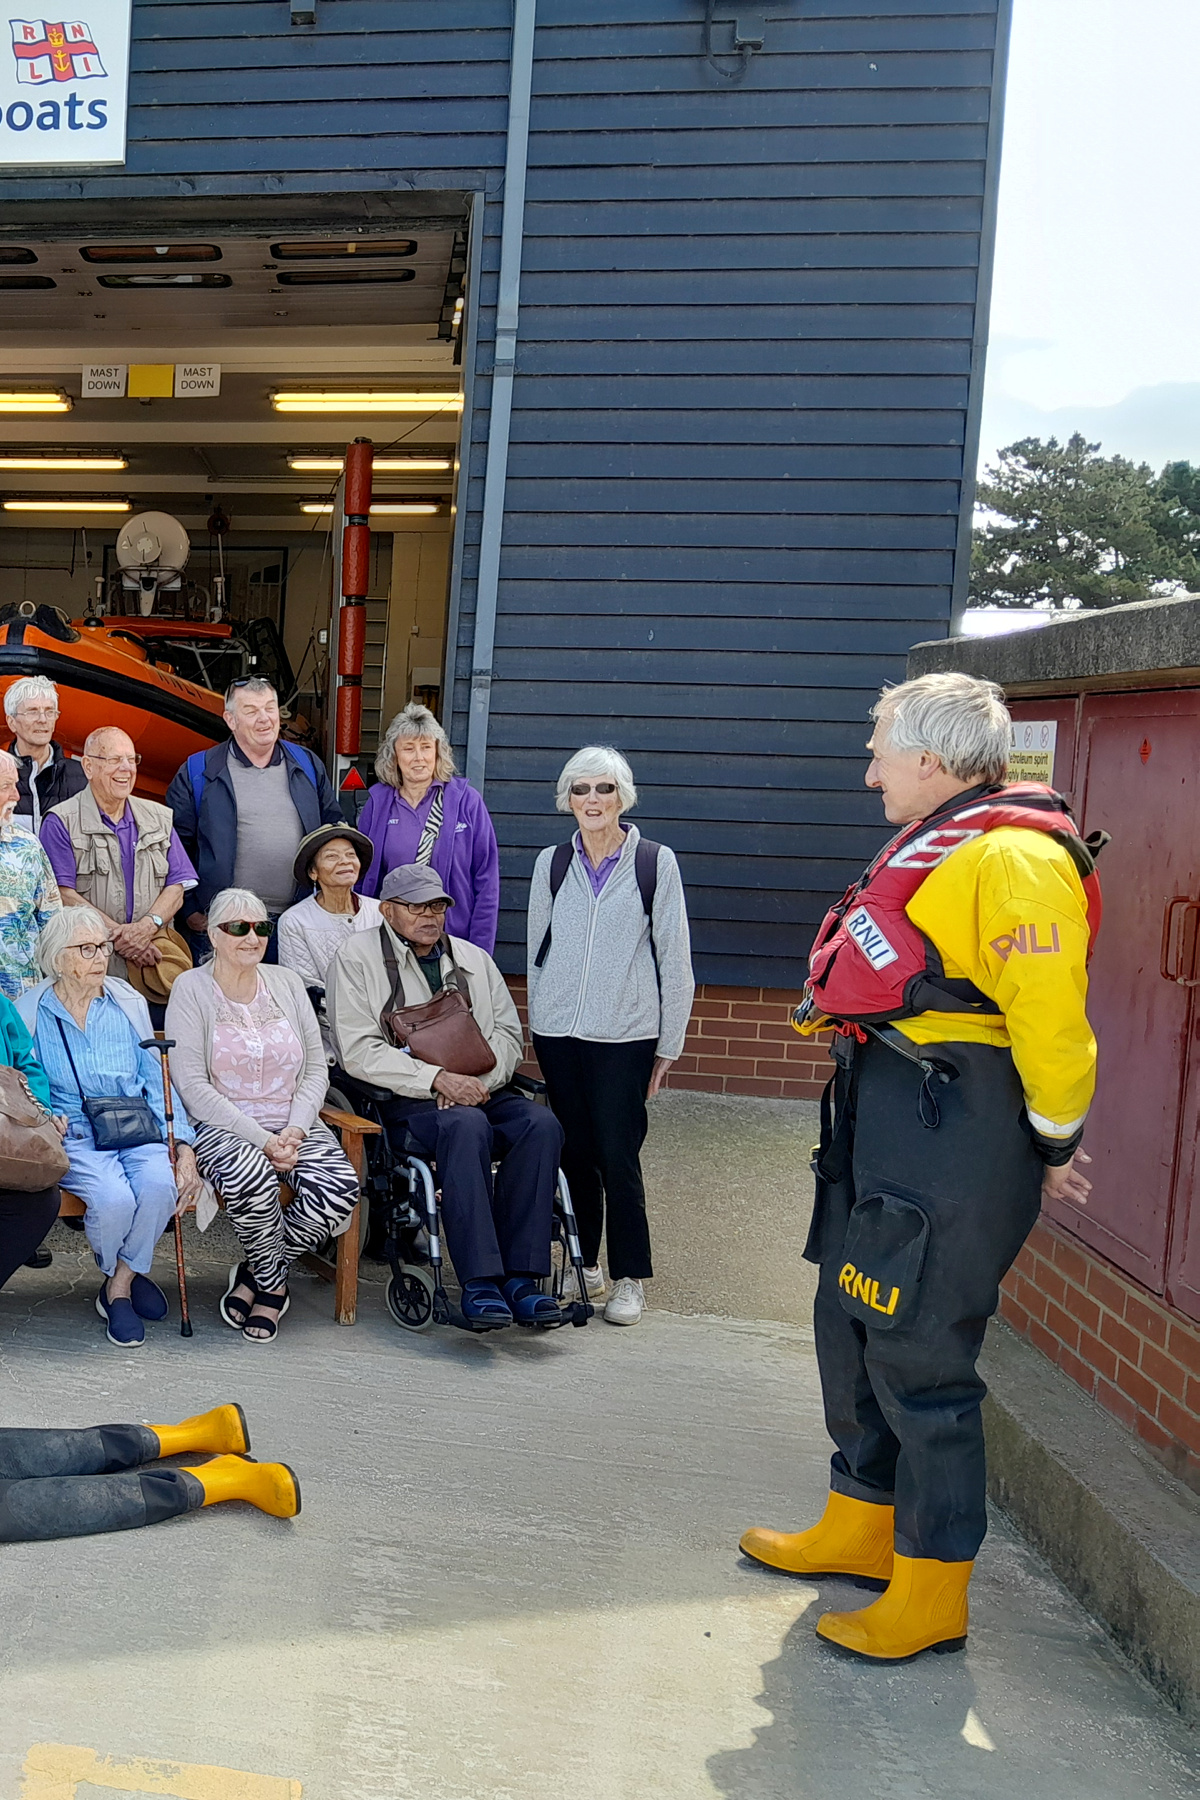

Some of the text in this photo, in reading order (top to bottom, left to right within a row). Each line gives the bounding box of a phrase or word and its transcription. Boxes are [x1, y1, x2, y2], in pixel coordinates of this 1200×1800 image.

[90, 368, 120, 377] MAST
[183, 367, 213, 377] MAST
[87, 380, 121, 390] DOWN
[180, 380, 215, 389] DOWN
[1008, 752, 1049, 768] etroleum spirit
[1007, 768, 1049, 782] ghly flammable
[849, 913, 890, 961] RNLI
[988, 922, 1061, 962] RNLI
[838, 1262, 900, 1316] RNLI
